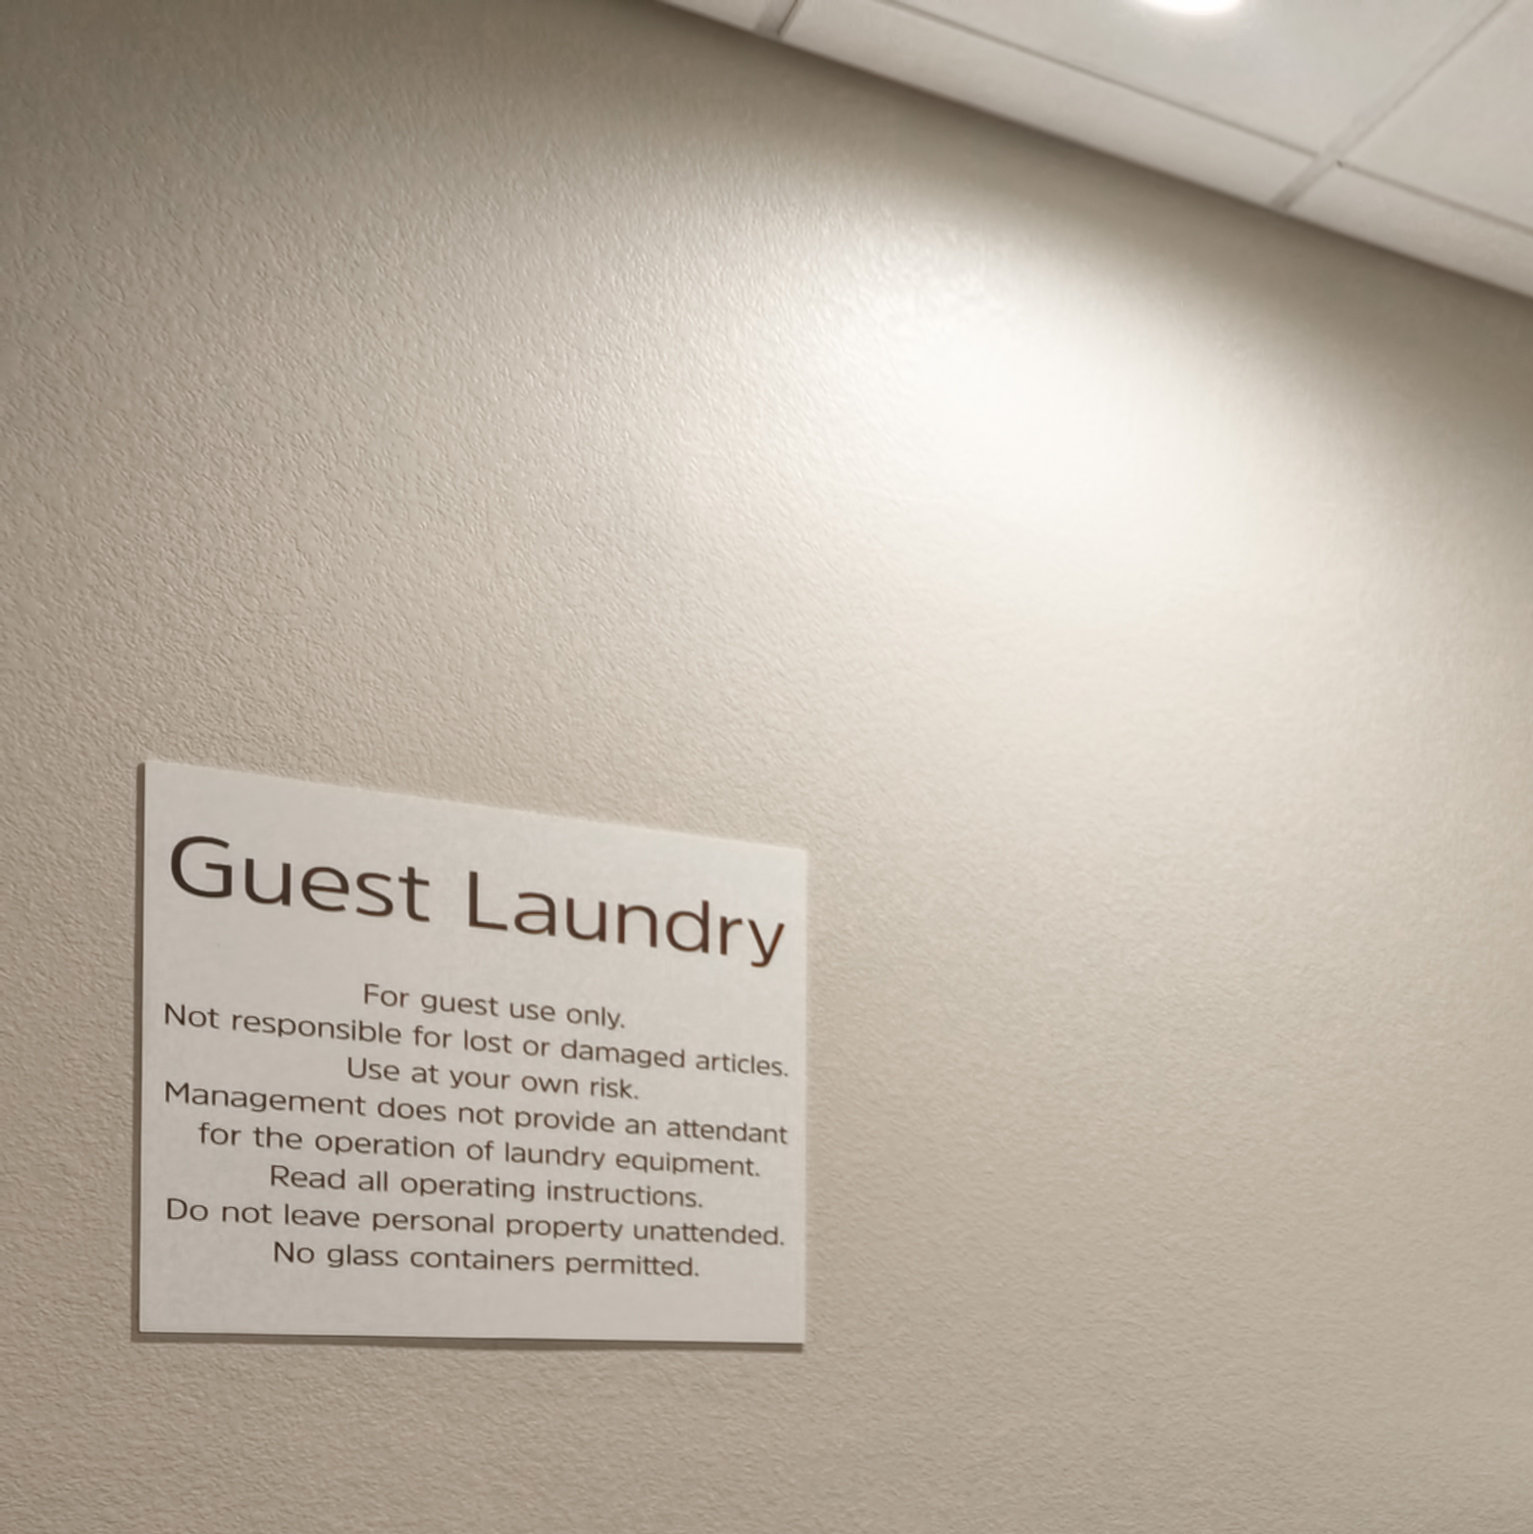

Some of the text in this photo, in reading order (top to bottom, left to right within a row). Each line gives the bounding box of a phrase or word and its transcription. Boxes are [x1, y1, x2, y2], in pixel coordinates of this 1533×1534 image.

[170, 835, 786, 969] Guest Laundry
[363, 982, 625, 1031] For guest use only.
[164, 1002, 789, 1078] Not responsible for lost or damaged articles.
[347, 1056, 639, 1100] Use at your own risk.
[164, 1080, 788, 1145] Management does not provide an attendant
[197, 1121, 761, 1177] for the operation of laundry equipment.
[270, 1164, 703, 1209] Read all operating instructions.
[166, 1197, 785, 1246] Do not leave personal property unattended.
[273, 1240, 700, 1277] No glass containers permitted.
